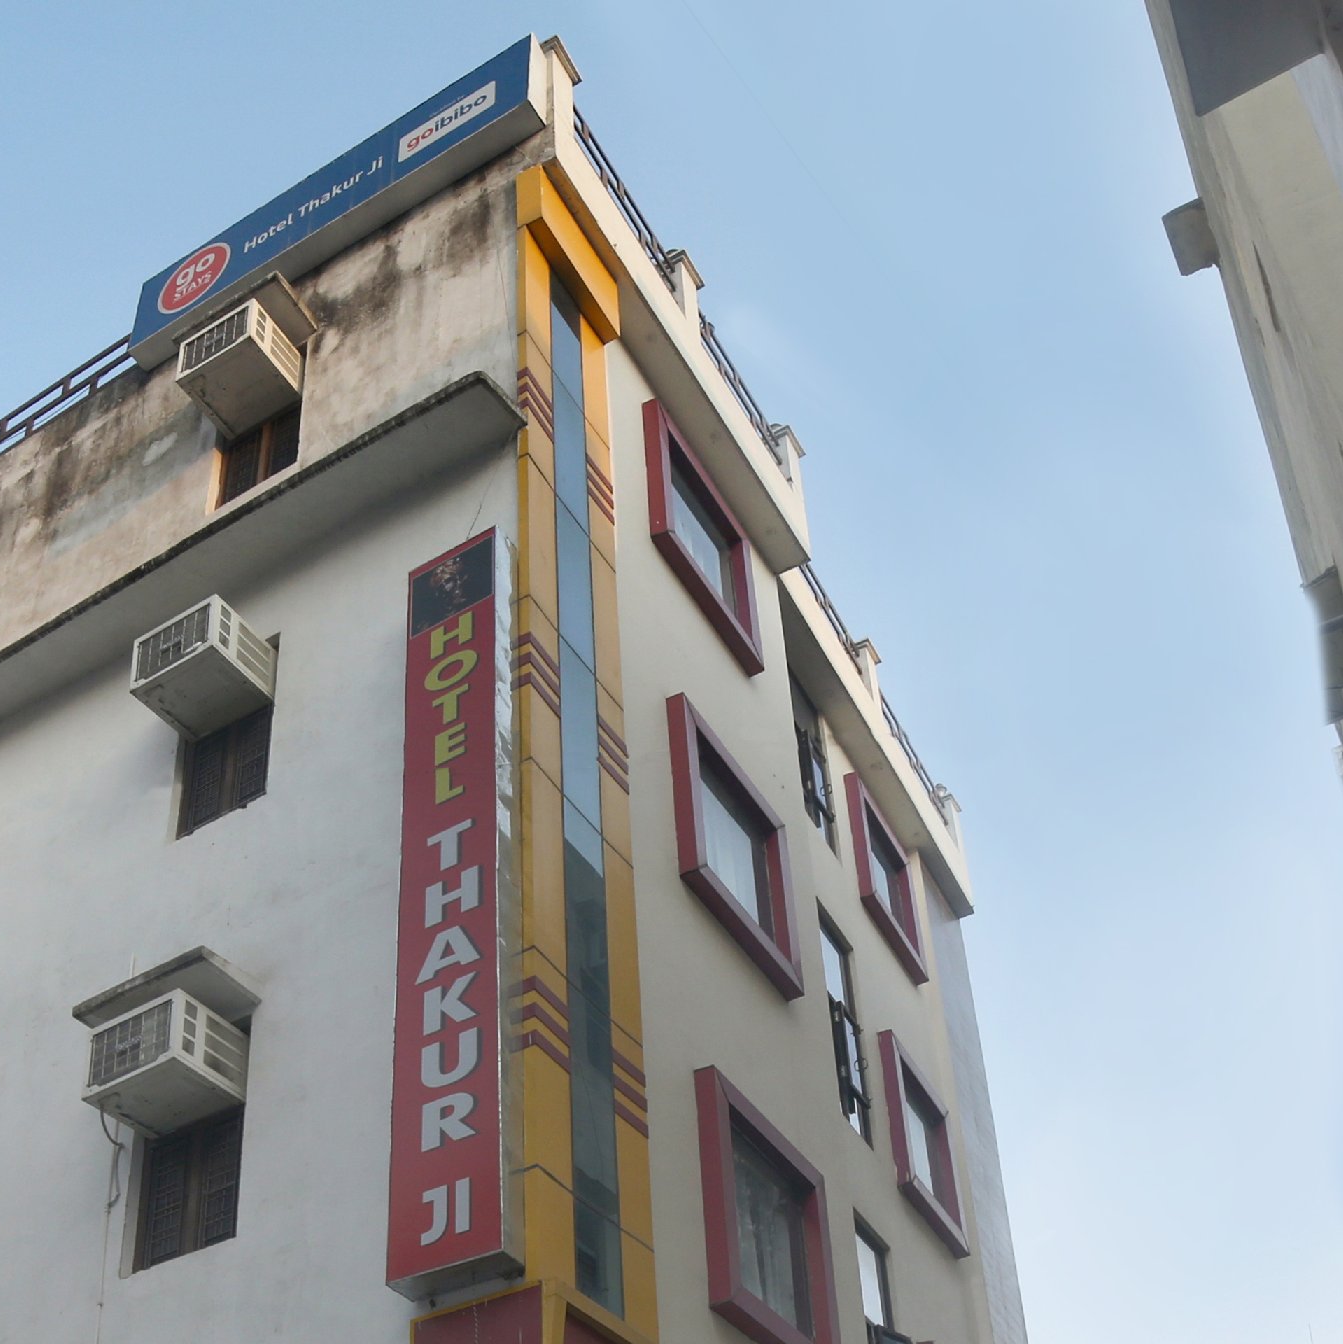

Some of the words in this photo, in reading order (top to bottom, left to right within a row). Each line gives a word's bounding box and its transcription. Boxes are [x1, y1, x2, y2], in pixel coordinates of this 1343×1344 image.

[406, 95, 488, 153] goibibo
[243, 212, 294, 253] Hotel
[298, 170, 364, 218] Thakur
[367, 155, 383, 176] Ji
[173, 271, 212, 304] STAYS
[176, 253, 215, 291] go
[423, 610, 479, 806] HOTEL
[414, 818, 484, 1153] THAKUR
[420, 1176, 472, 1247] JI
